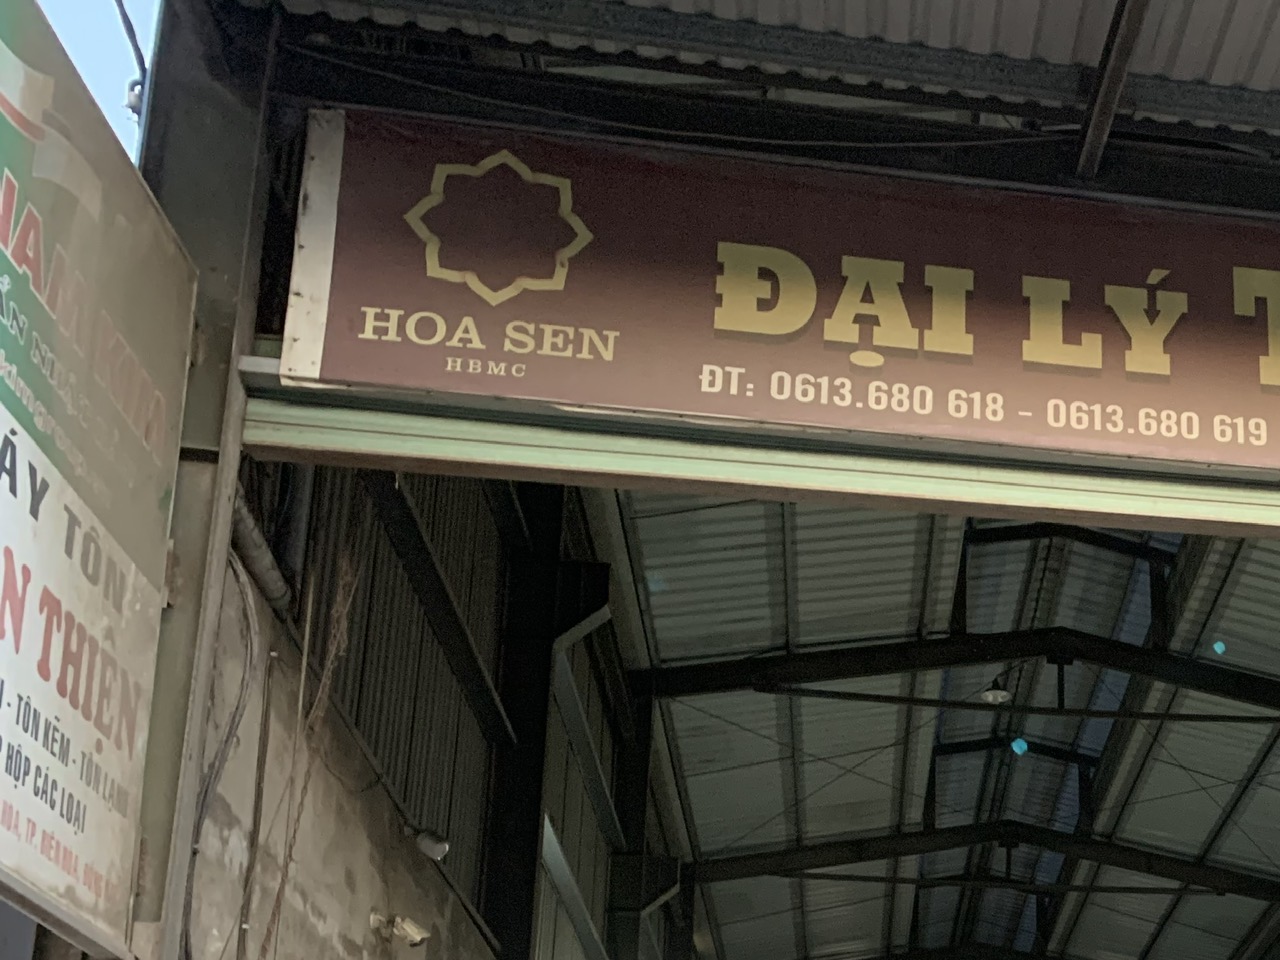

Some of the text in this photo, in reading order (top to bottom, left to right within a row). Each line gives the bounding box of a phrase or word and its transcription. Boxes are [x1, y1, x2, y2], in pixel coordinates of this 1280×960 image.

[358, 306, 620, 361] HOA SEN
[713, 241, 974, 368] ĐẠI
[1021, 269, 1189, 376] LÝ
[446, 357, 527, 377] HBMC
[699, 364, 754, 397] ĐT:
[770, 371, 933, 415] 0613.680
[948, 388, 1004, 421] 618
[1047, 398, 1200, 440] 0613.680
[1213, 414, 1268, 446] 619
[64, 503, 127, 615] TÔN
[37, 585, 141, 762] THIỆN
[15, 693, 41, 742] TÔN
[33, 766, 58, 811] CÁC
[59, 787, 87, 835] LOẠI
